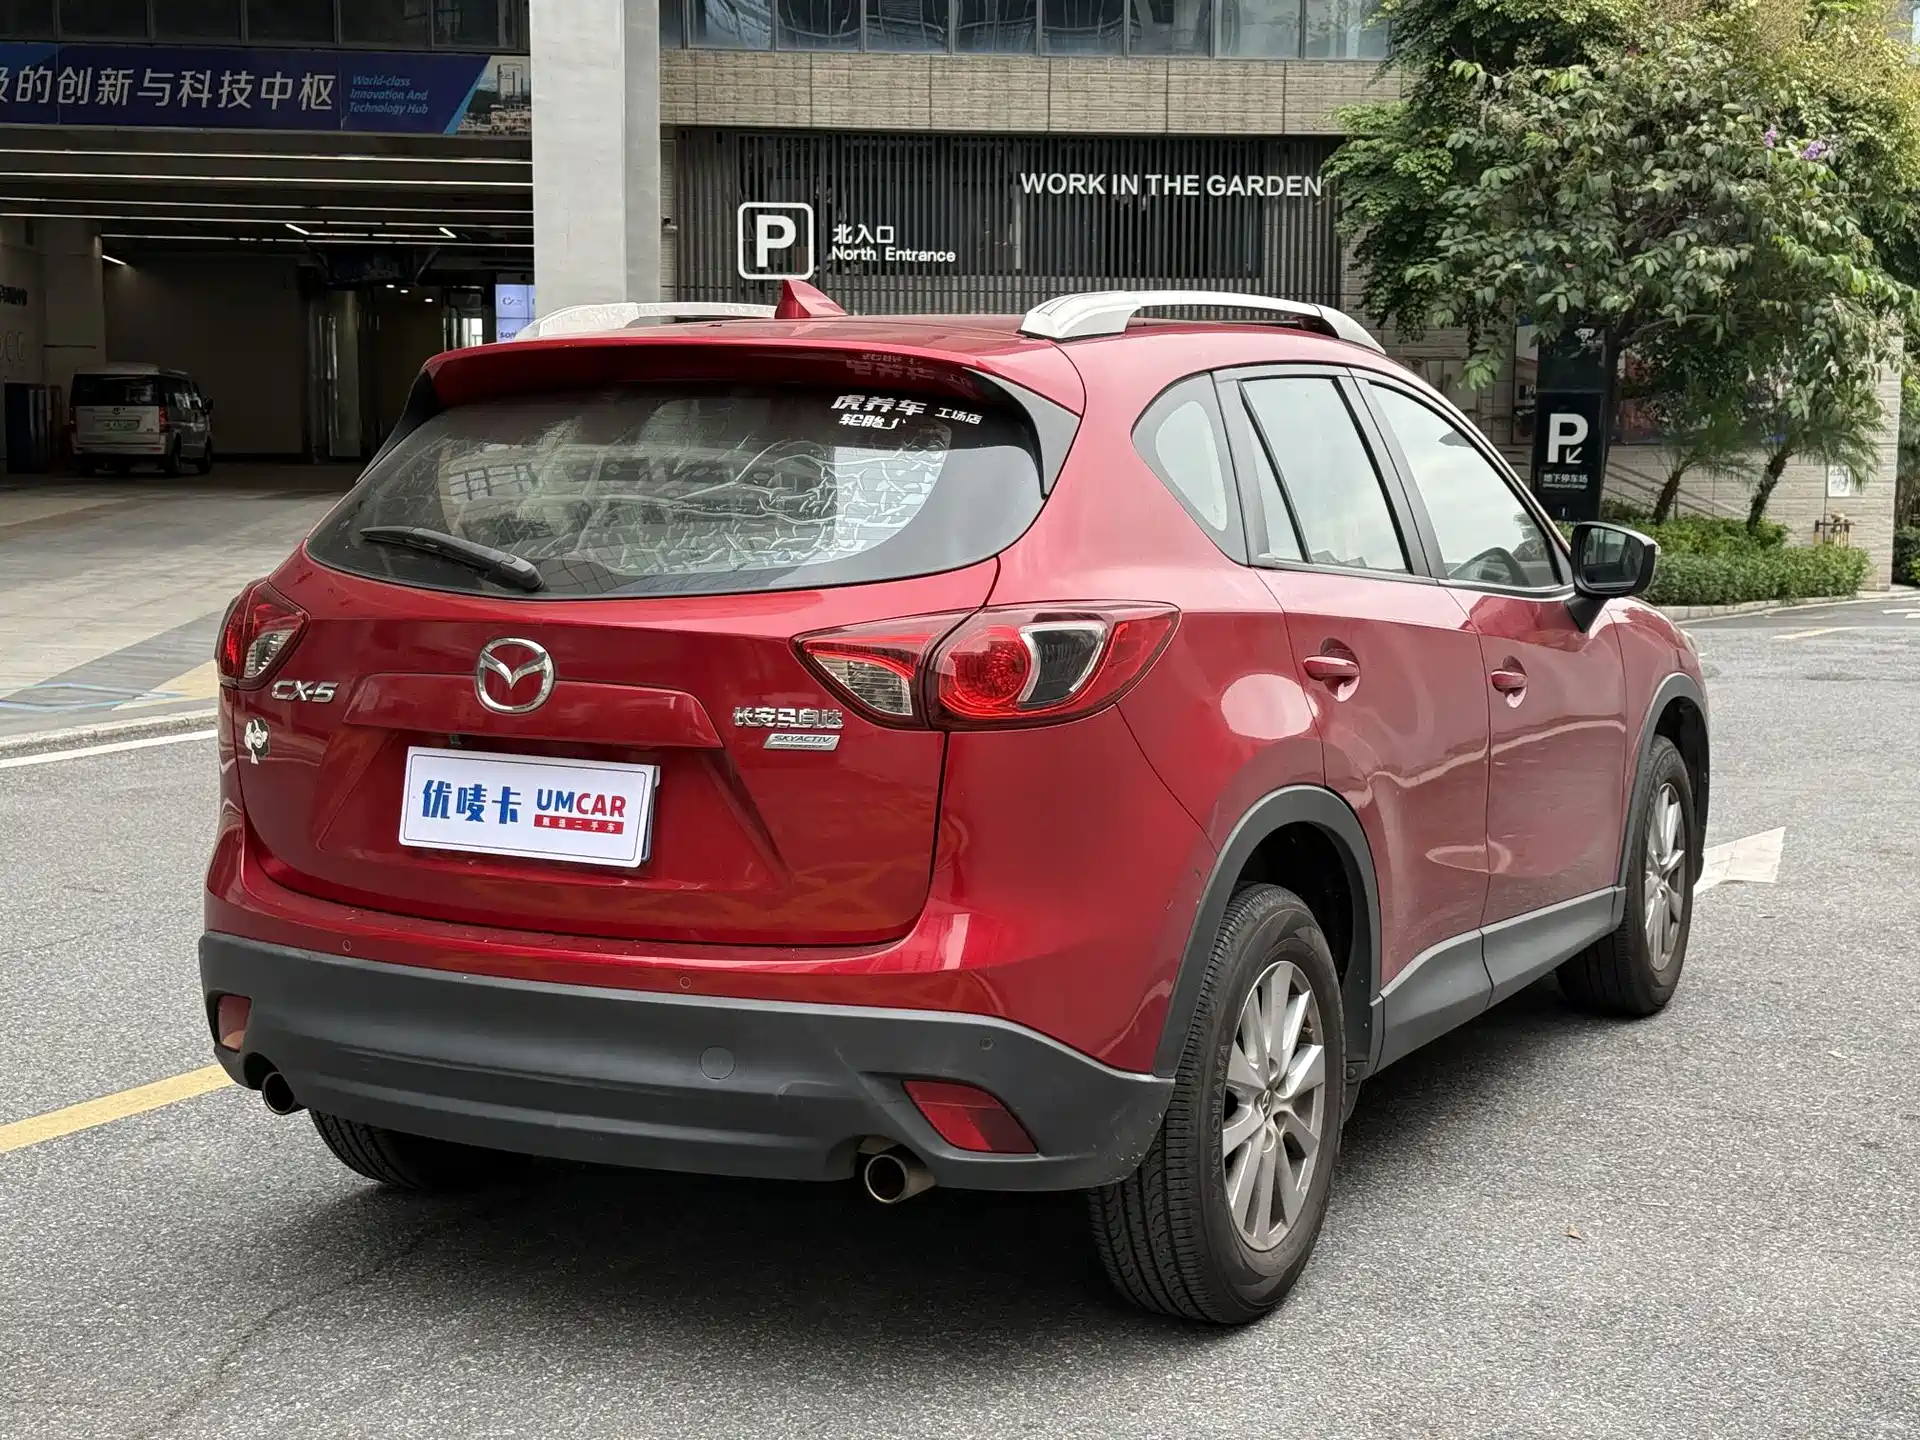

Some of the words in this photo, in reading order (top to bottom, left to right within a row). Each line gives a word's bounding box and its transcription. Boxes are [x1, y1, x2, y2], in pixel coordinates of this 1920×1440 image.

[353, 74, 411, 87] World-class
[350, 88, 404, 101] Innovation
[407, 89, 429, 101] And
[350, 101, 404, 115] Technology
[407, 103, 429, 115] Hub
[1020, 173, 1107, 195] WORK
[1112, 174, 1138, 195] IN
[1145, 174, 1200, 196] THE
[1206, 175, 1322, 197] GARDEN
[756, 214, 797, 268] P
[832, 223, 895, 245] 北入口
[831, 246, 877, 261] North
[885, 247, 957, 263] Entrance
[831, 394, 928, 416] 虎养车
[935, 407, 983, 425] 工场店
[1547, 413, 1589, 463] P
[271, 680, 340, 703] CX-5
[733, 707, 844, 729] 长安马自达
[773, 735, 836, 744] SKYACTIV
[422, 779, 522, 825] 优唛卡
[536, 788, 627, 818] UMCAR
